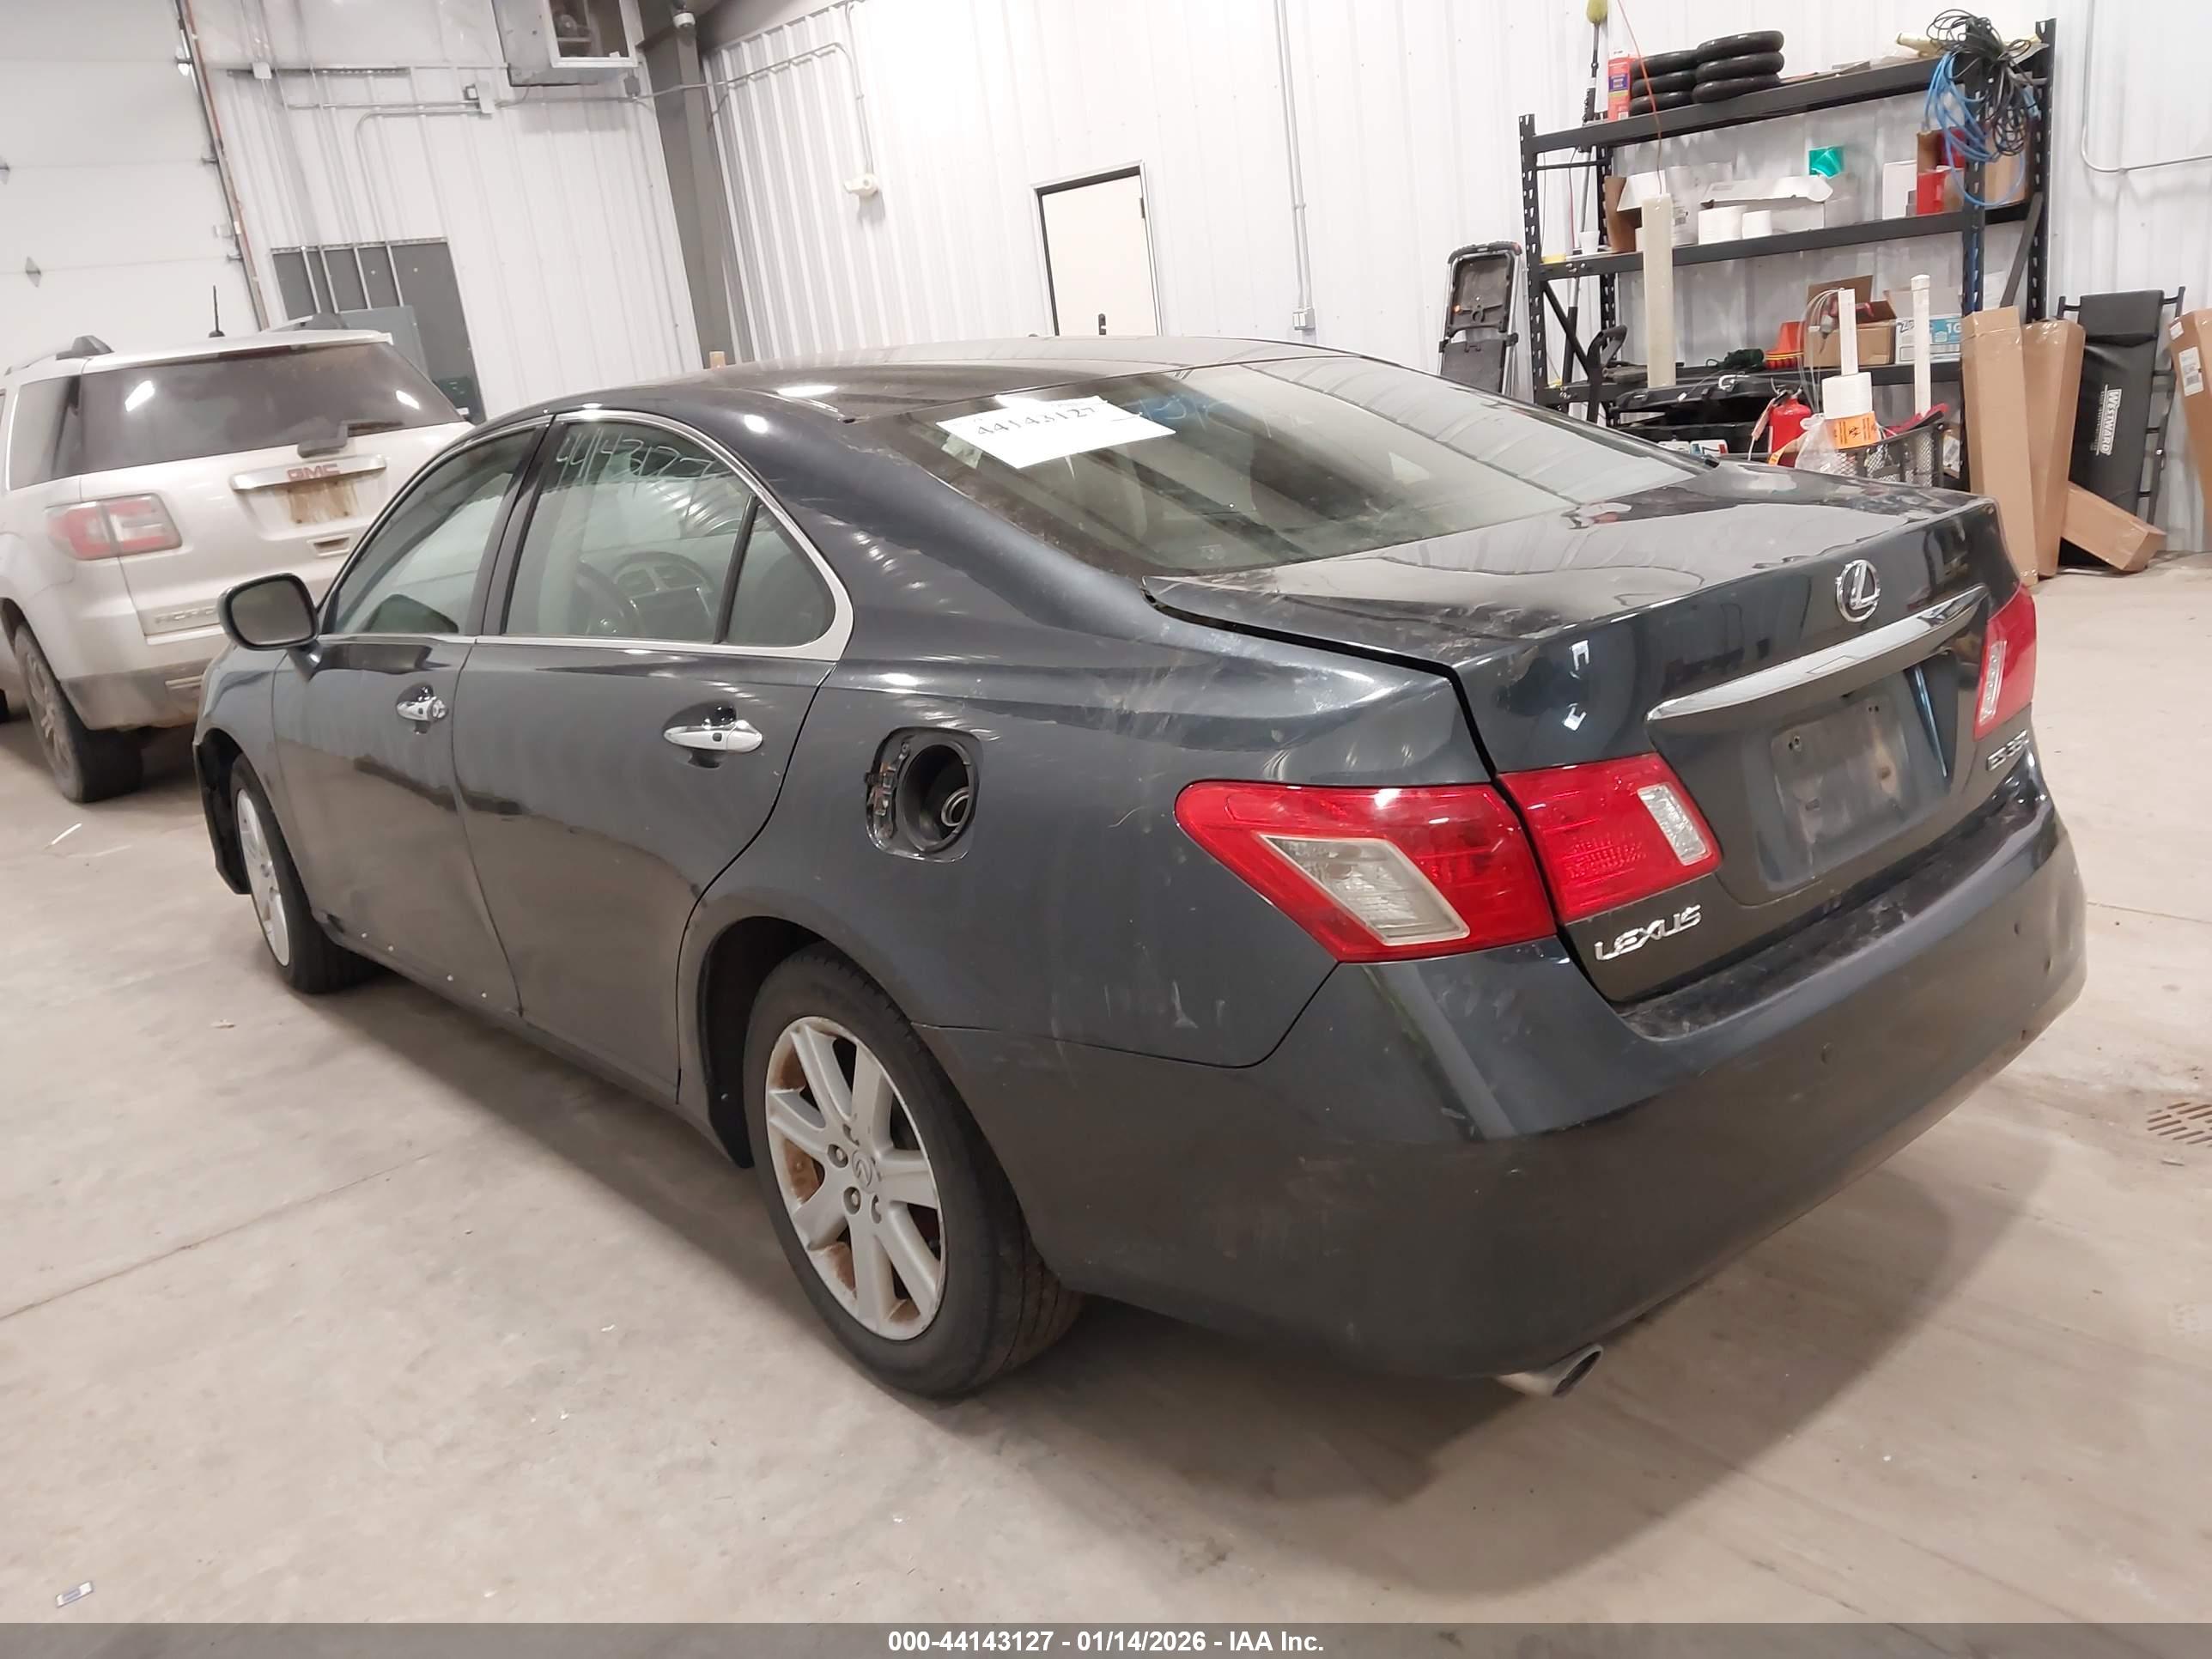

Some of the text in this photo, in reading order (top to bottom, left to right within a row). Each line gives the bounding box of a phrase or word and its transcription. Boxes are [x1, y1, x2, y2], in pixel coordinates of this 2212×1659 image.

[978, 406, 1096, 434] 44143127
[2100, 390, 2120, 453] WESTWARD
[287, 464, 341, 481] GMC
[1595, 904, 1701, 960] LEXUS
